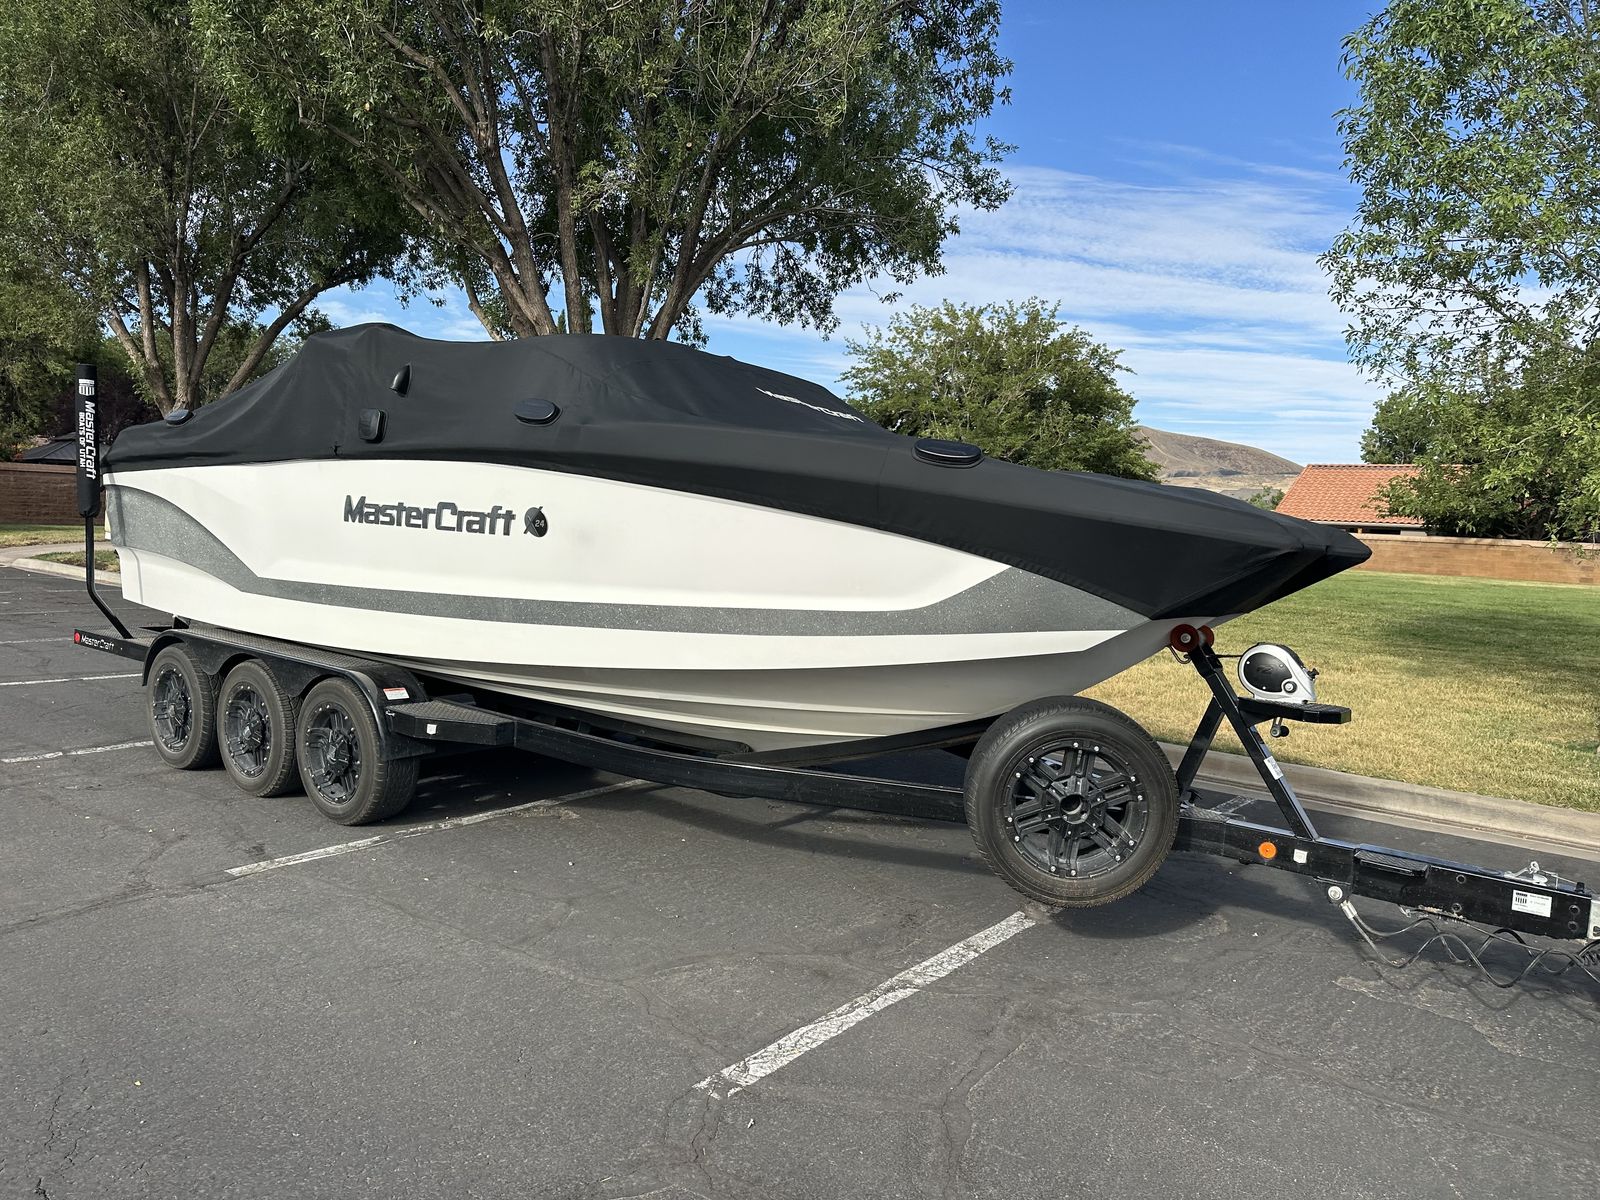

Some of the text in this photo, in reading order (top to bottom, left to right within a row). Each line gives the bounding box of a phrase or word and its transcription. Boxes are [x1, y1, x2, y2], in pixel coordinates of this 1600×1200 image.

[80, 437, 85, 447] OF
[85, 400, 96, 479] MasterCraft
[343, 494, 516, 536] MasterCraft
[81, 634, 115, 651] MasterCraft
